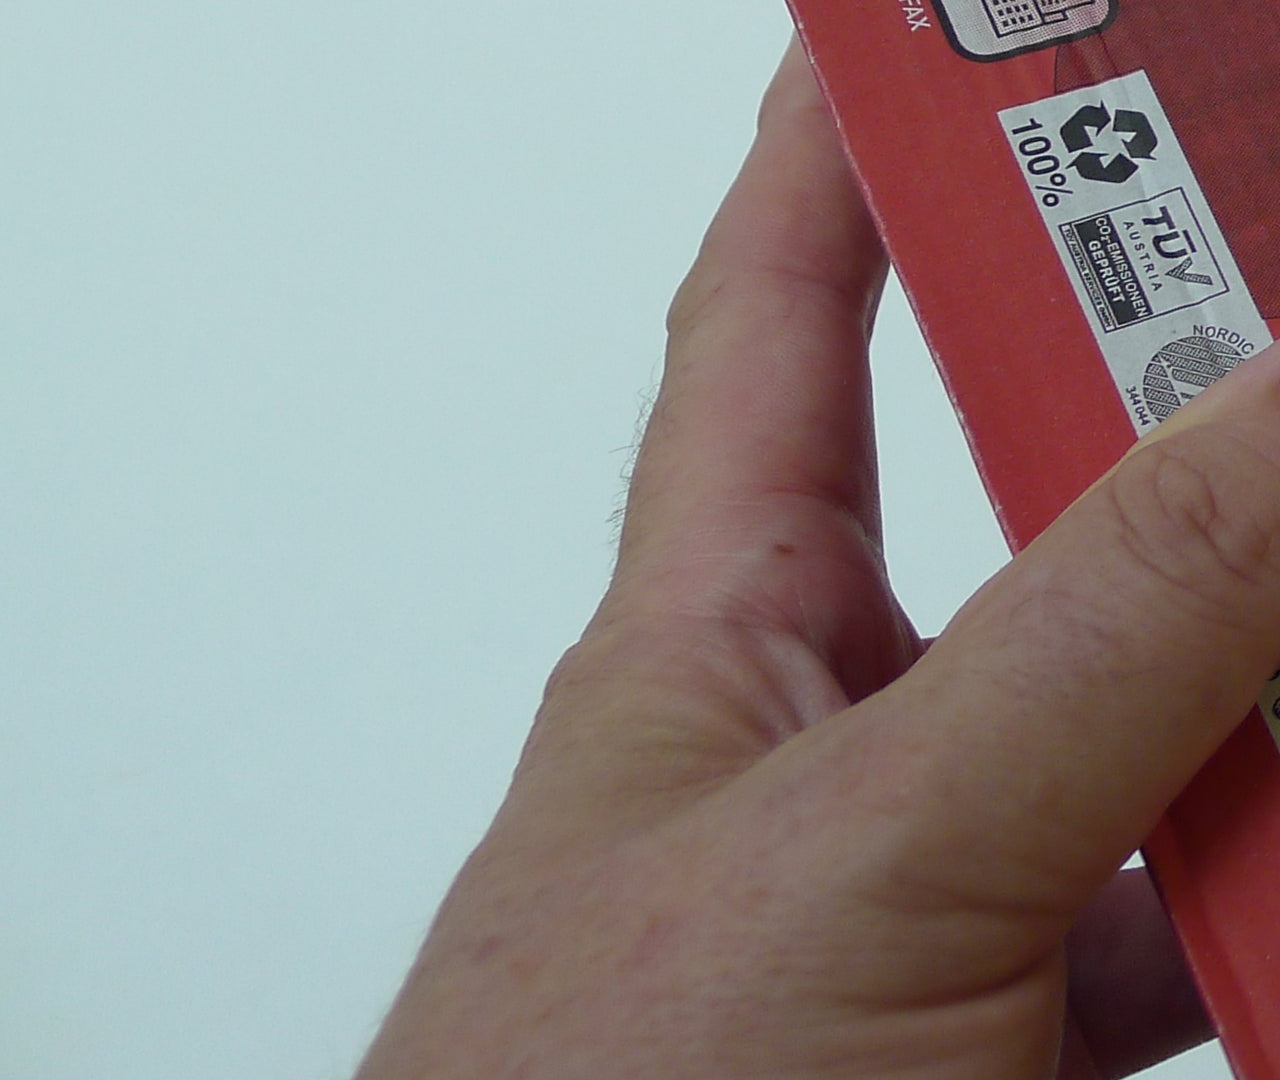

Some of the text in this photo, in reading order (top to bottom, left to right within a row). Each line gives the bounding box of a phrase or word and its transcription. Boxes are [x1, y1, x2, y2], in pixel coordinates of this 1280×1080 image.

[1012, 117, 1074, 208] 100%
[1087, 239, 1127, 304] GEPRÜFT
[1122, 221, 1163, 292] AUSTRIA
[1141, 206, 1213, 286] TÜV
[1192, 325, 1255, 354] NORDIC
